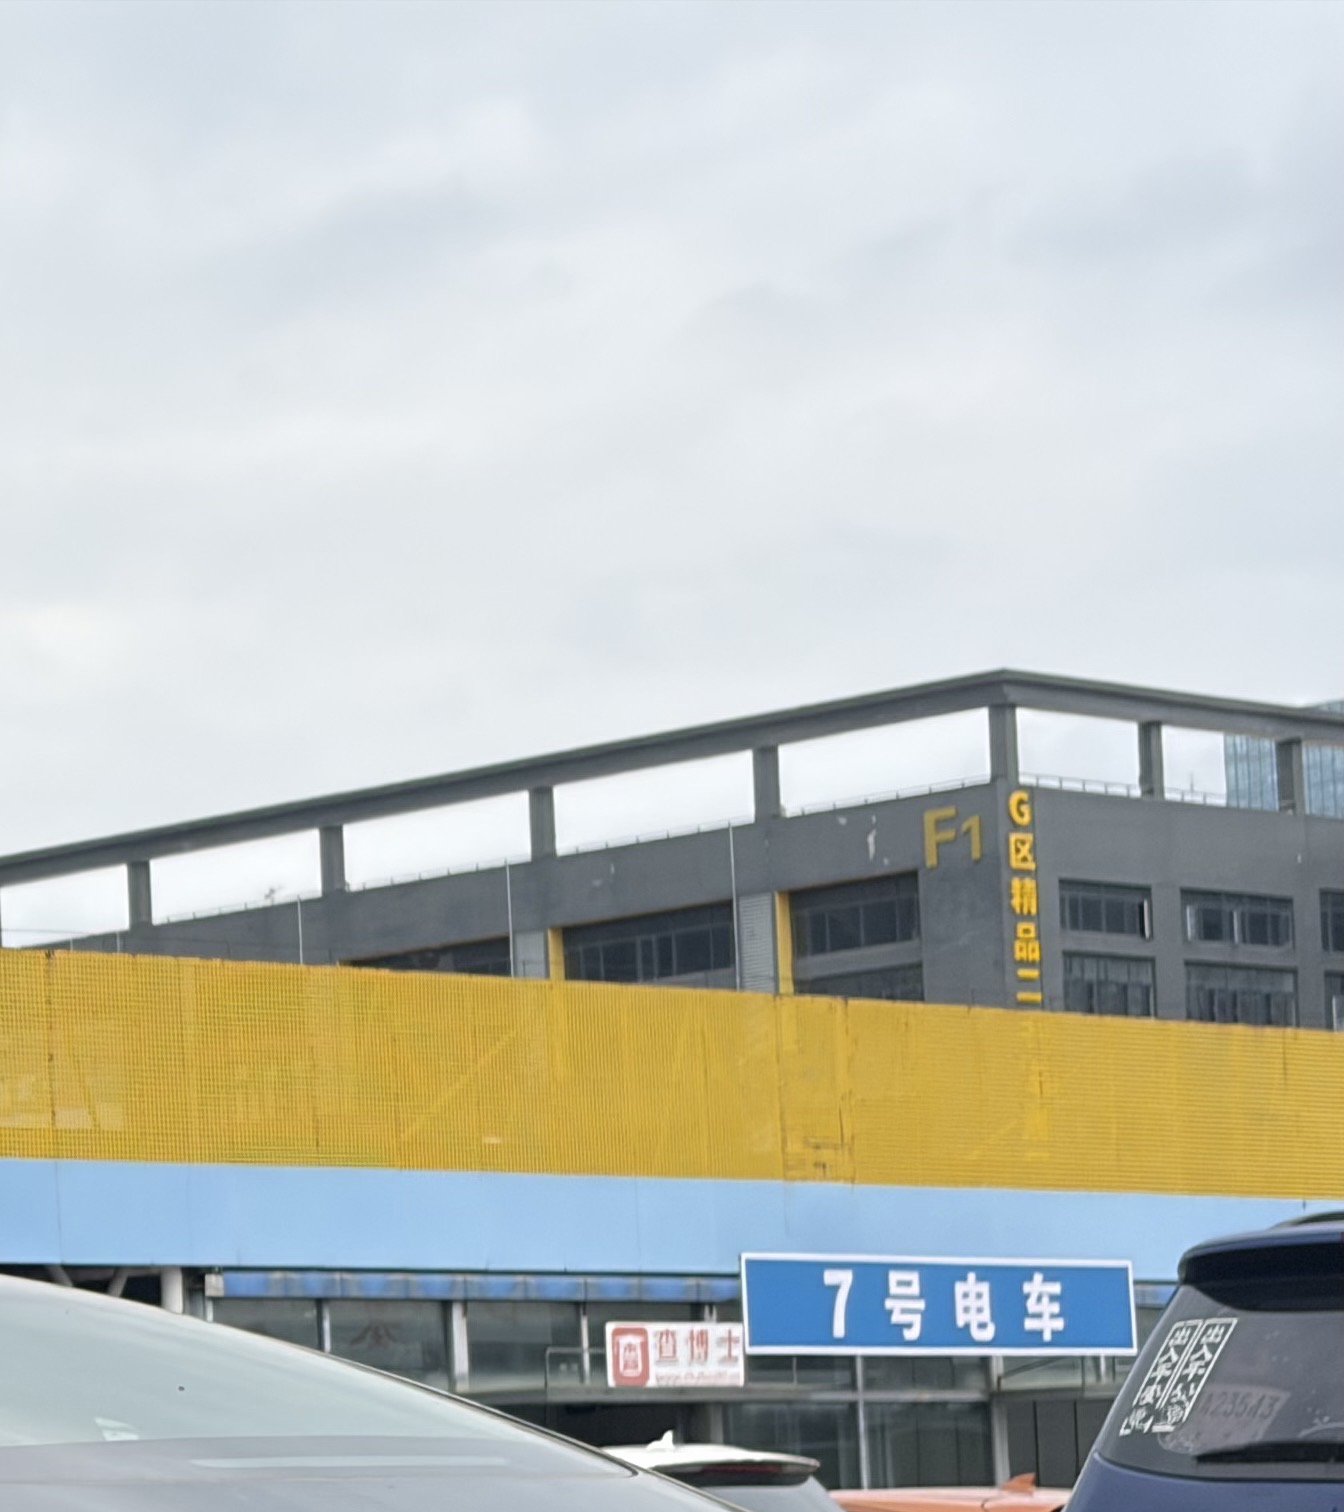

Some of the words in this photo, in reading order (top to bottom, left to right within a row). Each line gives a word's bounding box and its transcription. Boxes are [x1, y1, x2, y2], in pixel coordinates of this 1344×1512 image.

[922, 805, 982, 869] F1
[822, 1268, 1065, 1343] 7号电车
